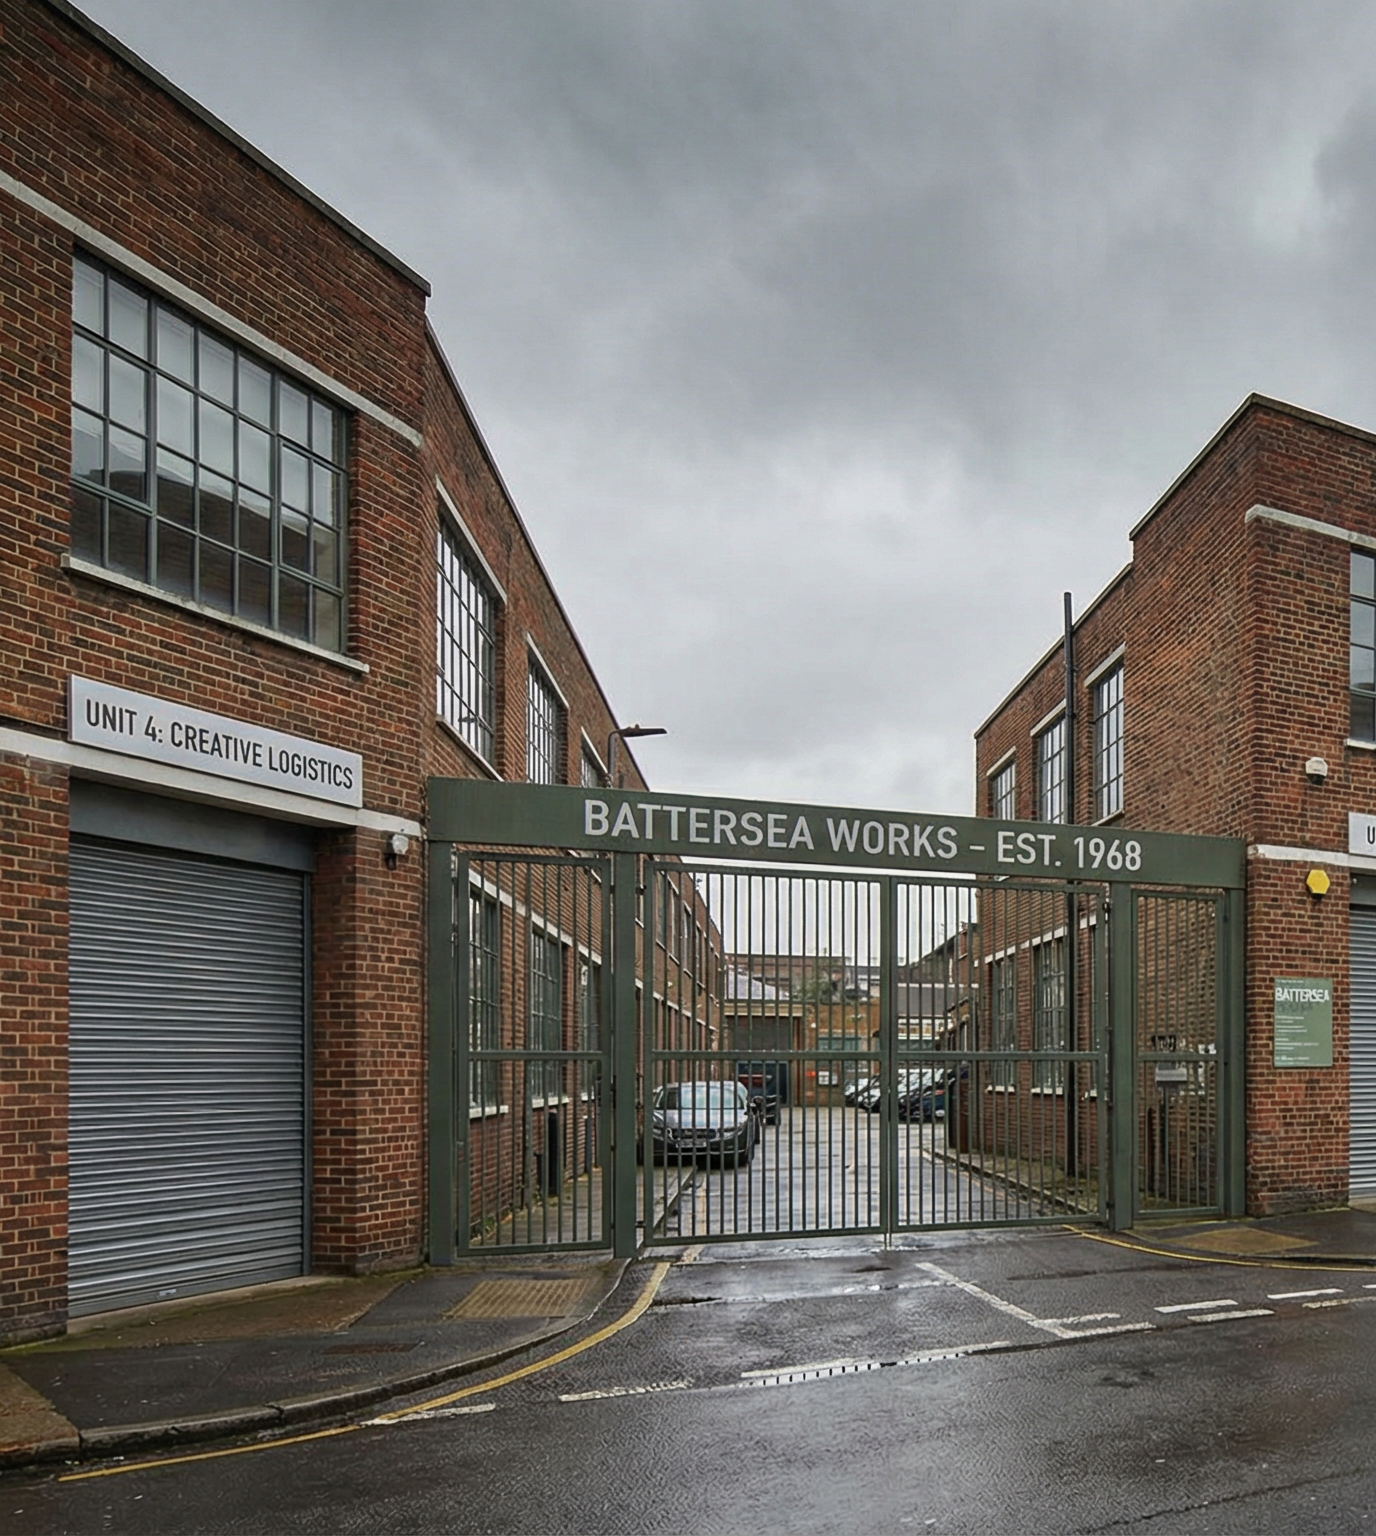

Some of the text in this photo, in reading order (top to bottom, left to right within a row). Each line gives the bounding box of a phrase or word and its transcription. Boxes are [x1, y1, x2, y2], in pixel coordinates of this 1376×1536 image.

[86, 698, 353, 790] UNIT 4: CREATIVE LOGISTICS
[584, 799, 815, 851] BATTERSEA
[826, 817, 958, 859] WORKS
[997, 831, 1062, 867] EST.
[1073, 836, 1142, 872] 1968
[1275, 987, 1330, 1003] BATTERSEA
